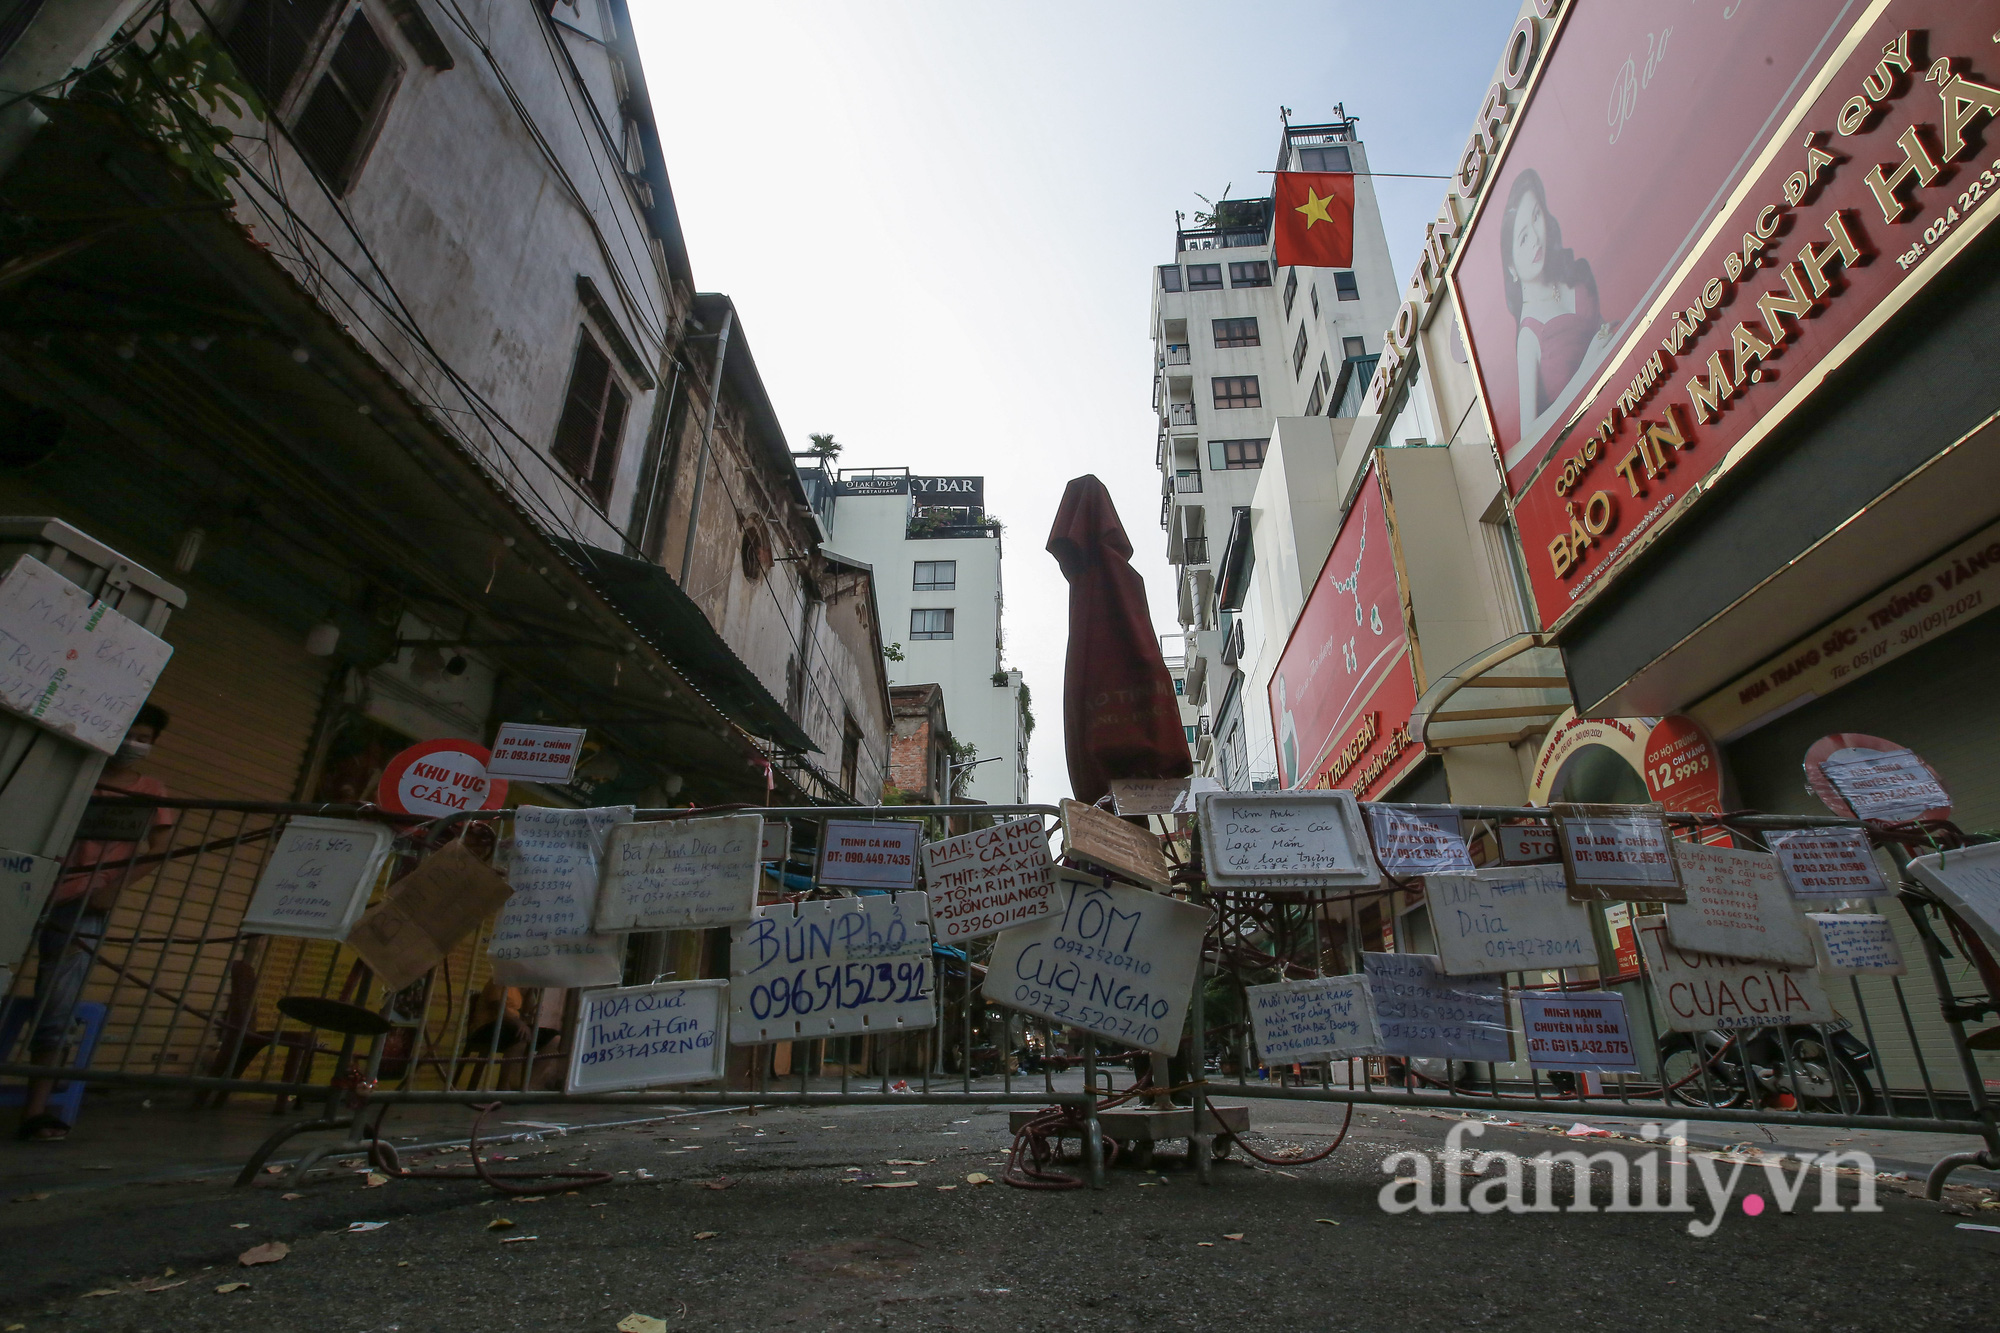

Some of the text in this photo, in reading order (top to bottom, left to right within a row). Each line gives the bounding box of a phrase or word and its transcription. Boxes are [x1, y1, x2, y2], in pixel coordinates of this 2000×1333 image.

[1896, 205, 1961, 270] Tel: 024
[1547, 30, 2000, 580] BẢO TÍN MẠNH HẢ
[1555, 437, 1597, 498] CÔNG
[1596, 408, 1615, 443] TY
[1616, 349, 1664, 418] TNHH
[1662, 277, 1724, 358] VÀNG
[1724, 204, 1779, 283] BẠC
[1782, 131, 1835, 207] ĐÁ
[936, 478, 976, 493] BAR
[1899, 590, 1983, 644] 30/09/2021
[1739, 679, 1771, 705] MUA
[1770, 650, 1821, 688] TRANG
[1822, 628, 1859, 657] SỨC
[1867, 584, 1935, 631] TRÚNG
[494, 749, 571, 764] ĐT: 093.612.9598
[517, 738, 572, 751] LÂN CHÍNH
[1328, 711, 1376, 785] TRUNG BÀY
[1542, 743, 1556, 768] TRANG
[1648, 731, 1698, 764] CƠ HỘI TRÚNG
[1672, 743, 1706, 766] CHỈ VÀNG
[412, 762, 486, 793] KHU VỰC
[1648, 755, 1709, 792] 12 999.9
[410, 784, 470, 810] CẤM
[868, 836, 881, 848] CÁ
[883, 840, 901, 849] KHO
[975, 827, 1003, 848] CÁ
[1005, 820, 1042, 840] KHO
[1594, 835, 1615, 846] LÂN
[827, 851, 911, 866] ĐT: 090.449.7435
[980, 835, 1043, 862] CÁ LỤC
[1575, 850, 1593, 862] ĐT:
[982, 858, 1013, 880] XÁ
[944, 886, 983, 903] TÔM
[947, 902, 1049, 936] 0396011443
[1061, 879, 1142, 953] TÔM
[1053, 936, 1152, 975] 0972520710
[1629, 954, 1639, 966] 12
[749, 962, 929, 1021] 0965152391
[590, 997, 633, 1023] HOA
[1543, 1007, 1570, 1018] MINH
[1534, 1021, 1573, 1033] CHUYÊN
[1531, 1039, 1630, 1054] ĐT: 0915.432.675
